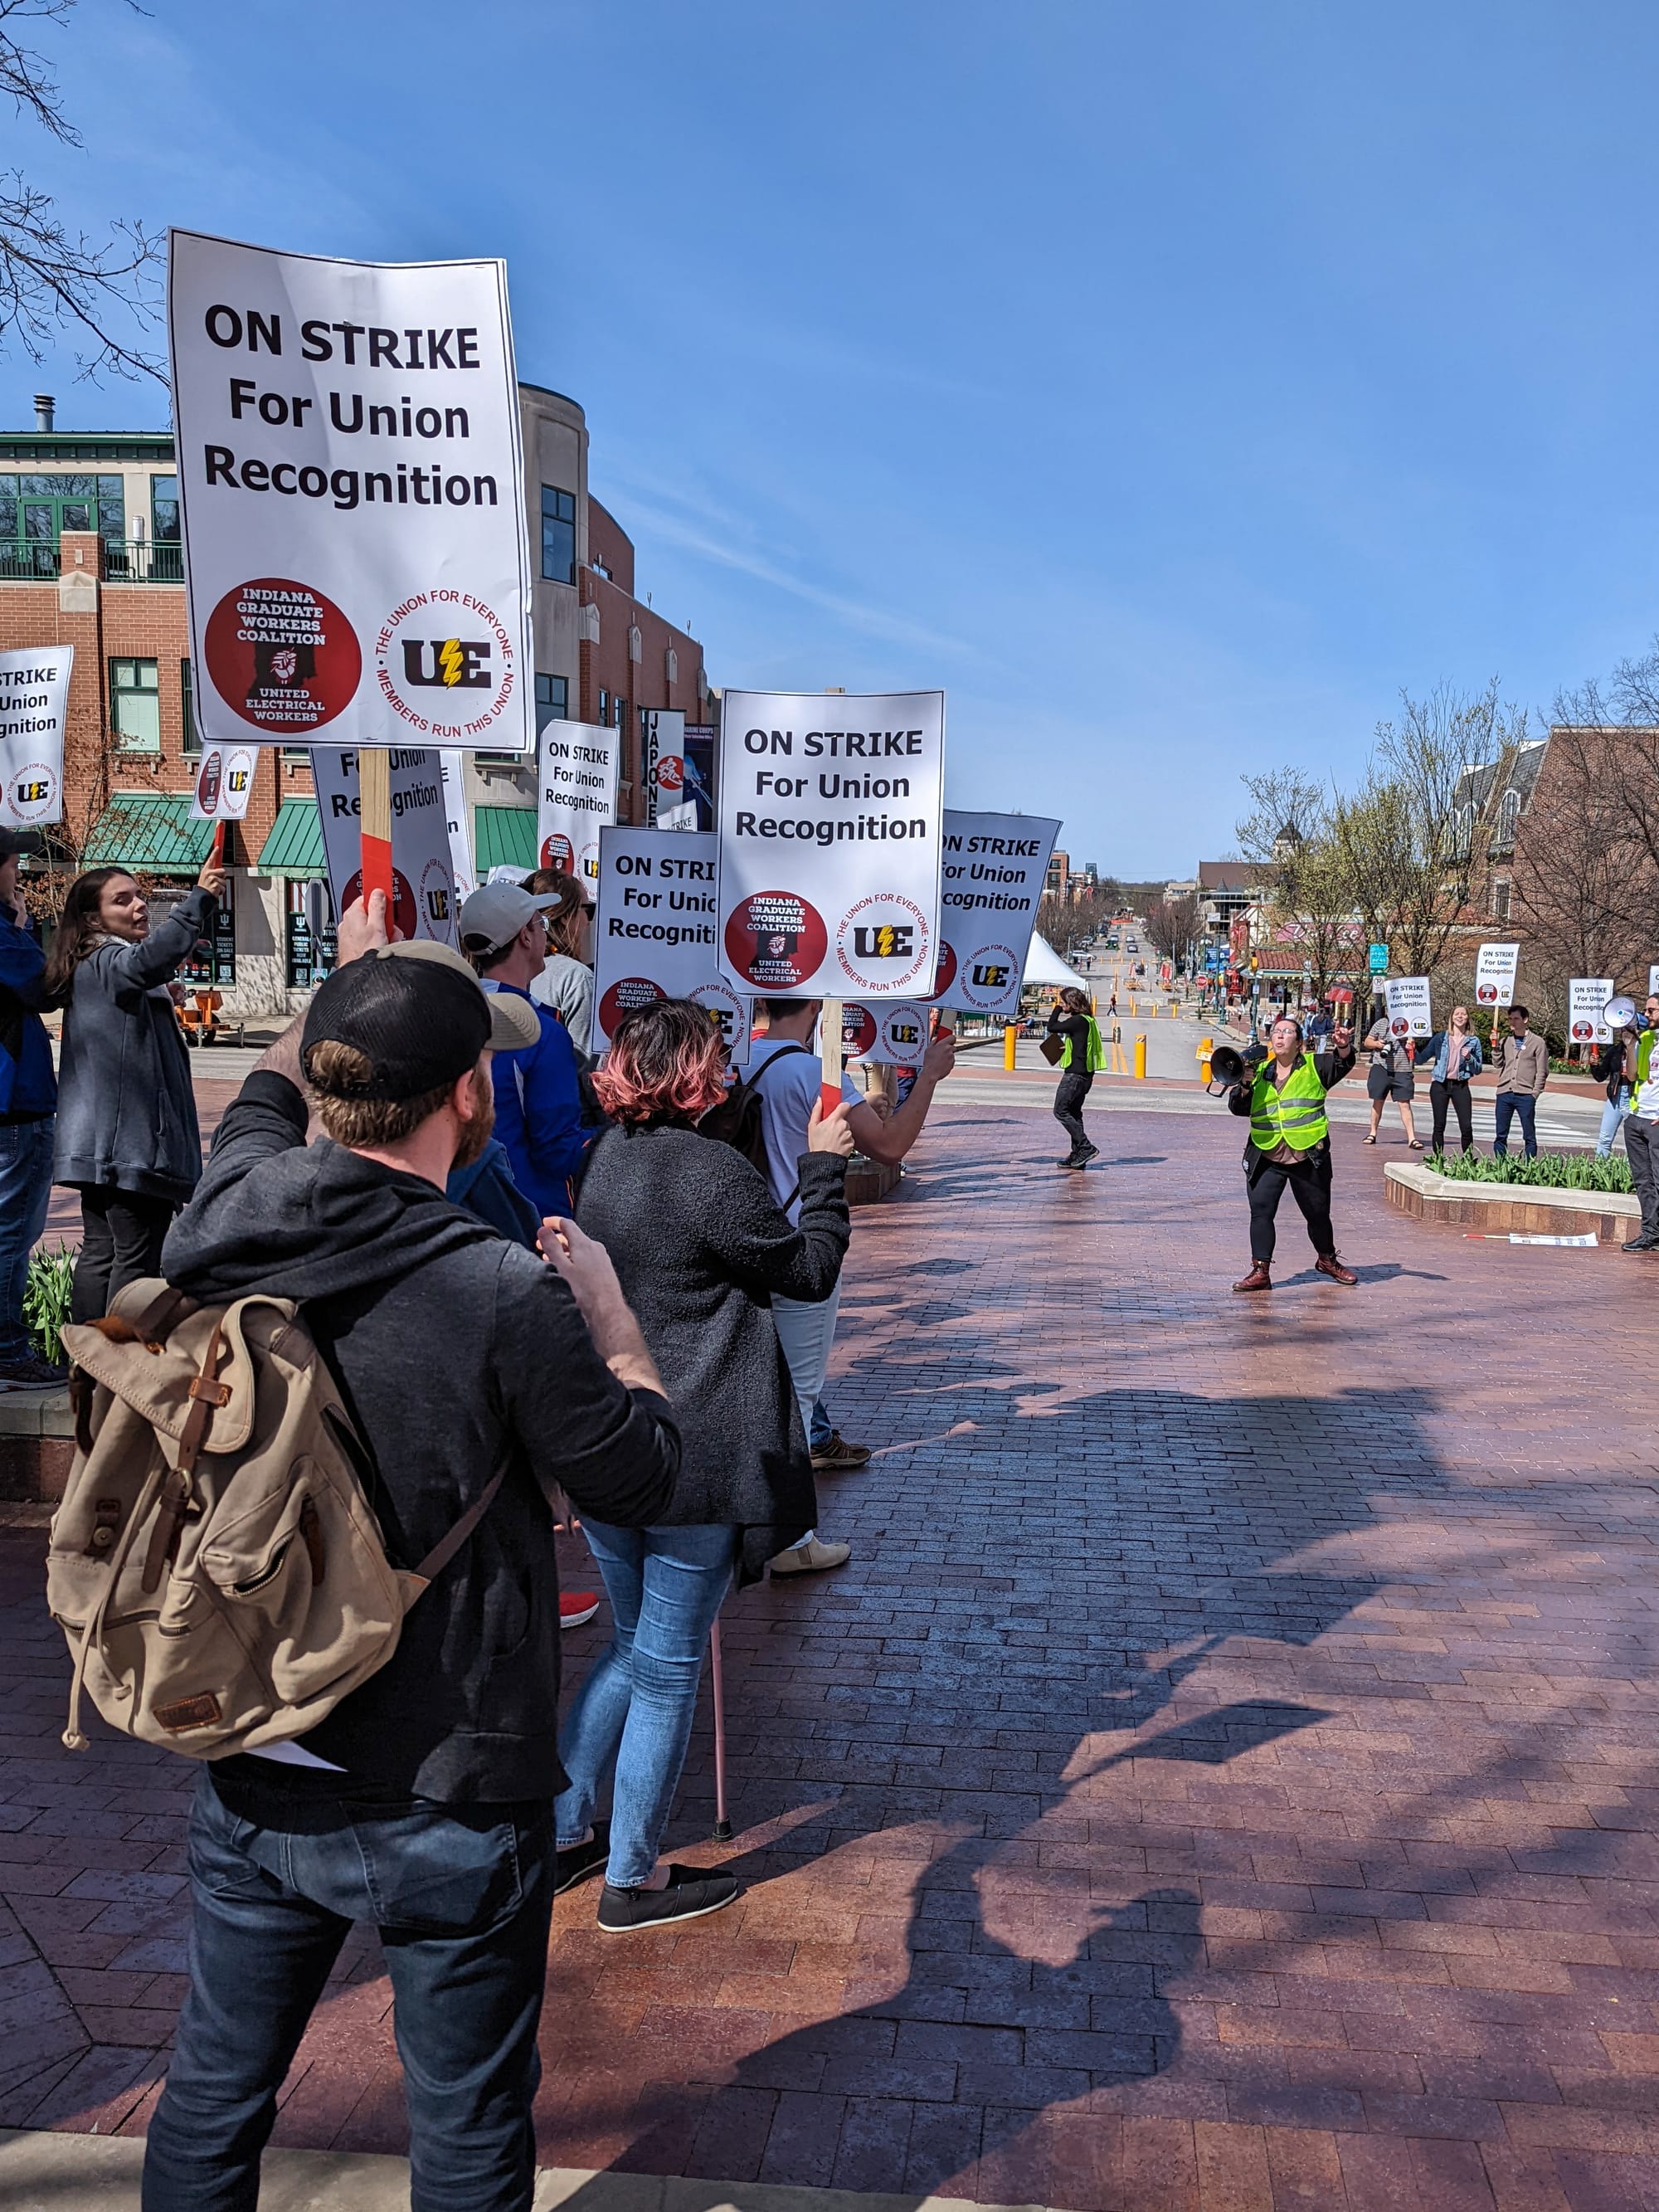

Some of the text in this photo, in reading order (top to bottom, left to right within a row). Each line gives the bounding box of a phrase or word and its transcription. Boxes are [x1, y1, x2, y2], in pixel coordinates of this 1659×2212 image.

[205, 305, 480, 369] ON STRIKE
[230, 378, 469, 438] For Union
[205, 444, 498, 510] Recognition
[242, 588, 316, 604] INDIANA
[236, 602, 324, 618] GRADUATE
[241, 616, 321, 631] WORKERS
[376, 590, 513, 660] THE UNION FOR EVERYONE
[236, 630, 326, 646] COALITION
[401, 638, 492, 690] UE
[0, 694, 48, 712] Union
[246, 699, 325, 711] ELECTRICAL
[260, 688, 309, 699] UNITED
[377, 669, 514, 738] MEMBERS RUN THIS UNION
[0, 716, 56, 738] gnition
[254, 711, 319, 722] WORKERS
[549, 743, 609, 765] ON STRIKE
[744, 728, 923, 757] ON STRIKE
[229, 770, 249, 792] UE
[554, 766, 604, 789] For Union
[756, 771, 910, 799] For Union
[17, 781, 49, 802] UE
[331, 784, 438, 817] Regnition
[546, 788, 609, 814] Recognition
[667, 817, 692, 830] TRIKE
[736, 811, 926, 846] Recognition
[966, 836, 1041, 856] STRIKE
[584, 859, 598, 879] U
[615, 855, 715, 881] ON STRI
[941, 861, 1026, 884] or Union
[426, 889, 448, 921] UE
[624, 887, 716, 913] For Unio
[748, 905, 805, 915] GRADUATE
[753, 897, 801, 906] INDIANA
[941, 892, 1030, 911] cognition
[751, 914, 803, 923] WORKERS
[836, 894, 929, 938] THE UNION FOR EVERYONE
[608, 918, 716, 946] Recogniti
[747, 923, 805, 933] COALITION
[854, 926, 913, 959] UE
[836, 947, 868, 987] MEMBERS
[869, 982, 889, 992] RUN
[892, 973, 912, 988] THIS
[910, 945, 928, 975] UNION
[962, 958, 972, 971] THE
[971, 946, 990, 959] UNION
[1003, 947, 1019, 976] EVERYONE
[620, 982, 654, 990] INDIANA
[972, 964, 1010, 987] UE
[616, 988, 658, 996] GRADUATE
[688, 984, 705, 1001] NION
[721, 987, 745, 1021] EVERYONE
[961, 977, 977, 1005] MEMBERS
[990, 997, 1003, 1008] THIS
[1002, 981, 1017, 1000] UNION
[730, 1026, 745, 1049] UNION
[891, 1024, 918, 1045] UE
